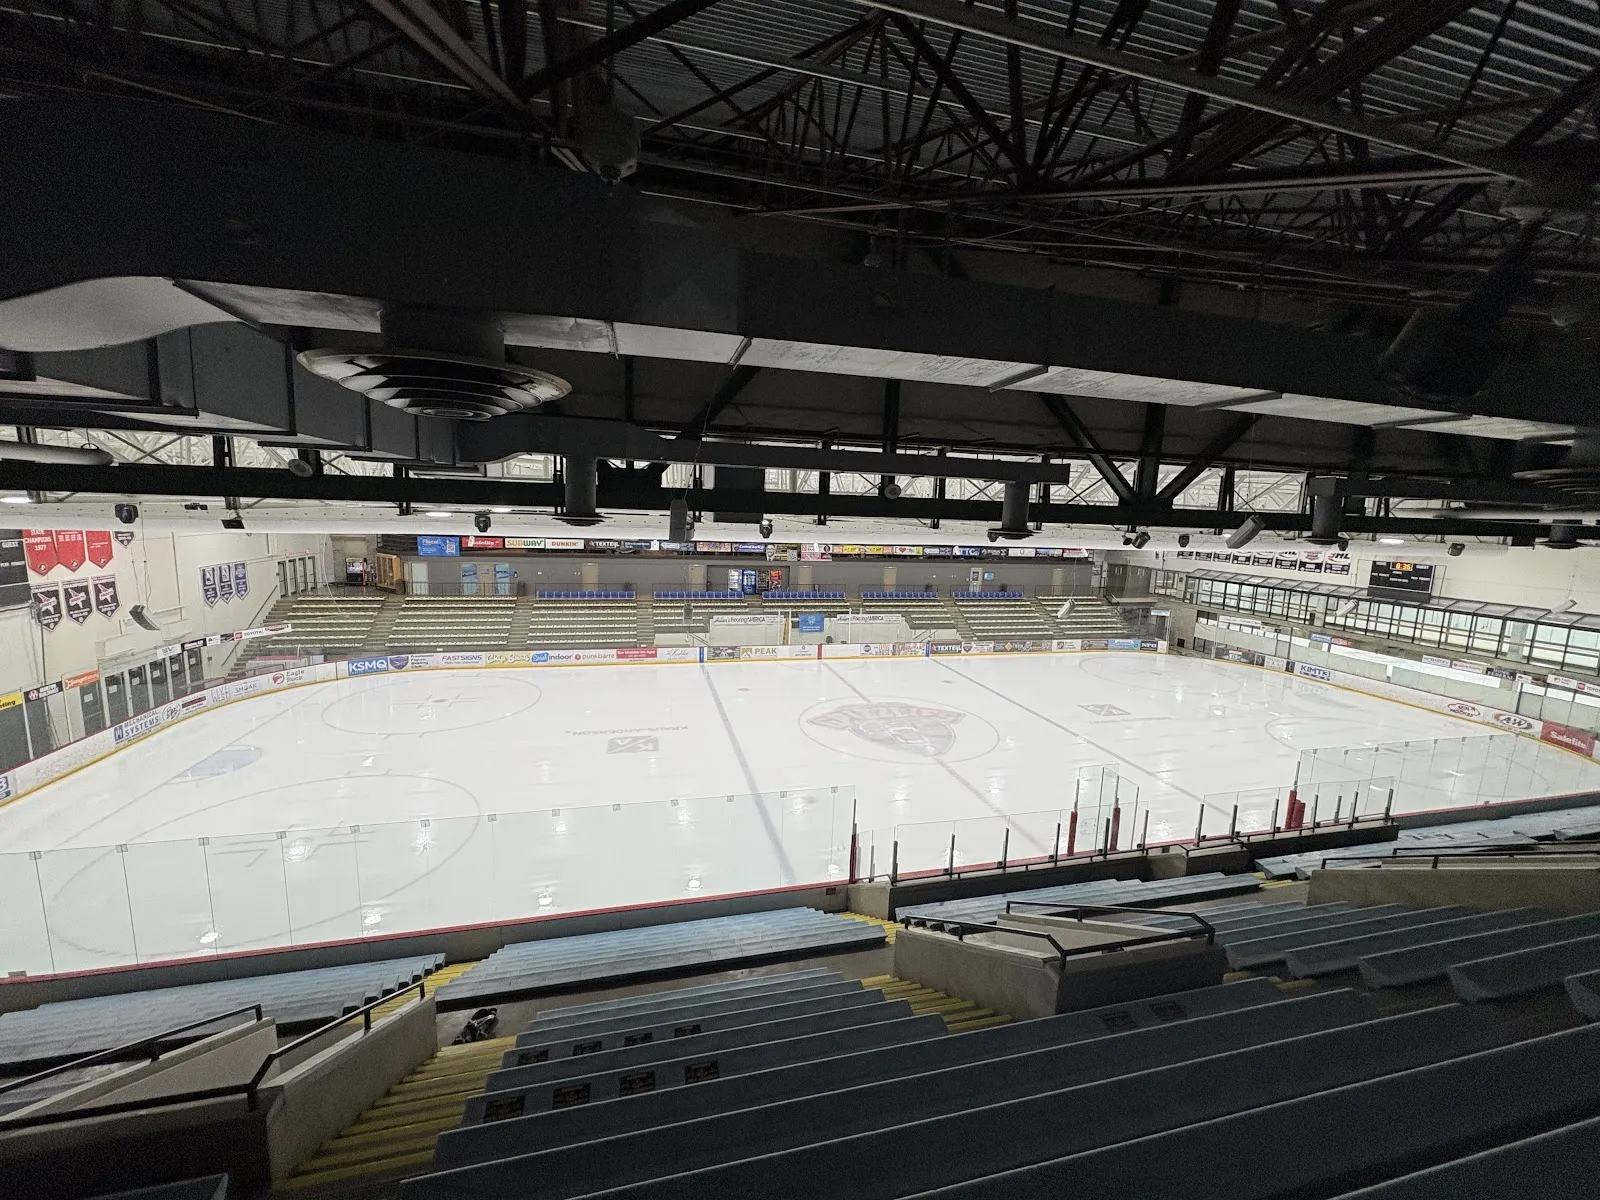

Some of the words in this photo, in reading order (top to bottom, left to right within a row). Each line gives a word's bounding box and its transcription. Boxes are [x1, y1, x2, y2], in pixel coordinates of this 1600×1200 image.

[507, 539, 544, 547] SUBWAY
[754, 647, 777, 655] PEAK
[348, 659, 387, 672] KSMQ
[124, 709, 159, 728] MECHANICAL
[125, 716, 160, 737] SYSTEMS
